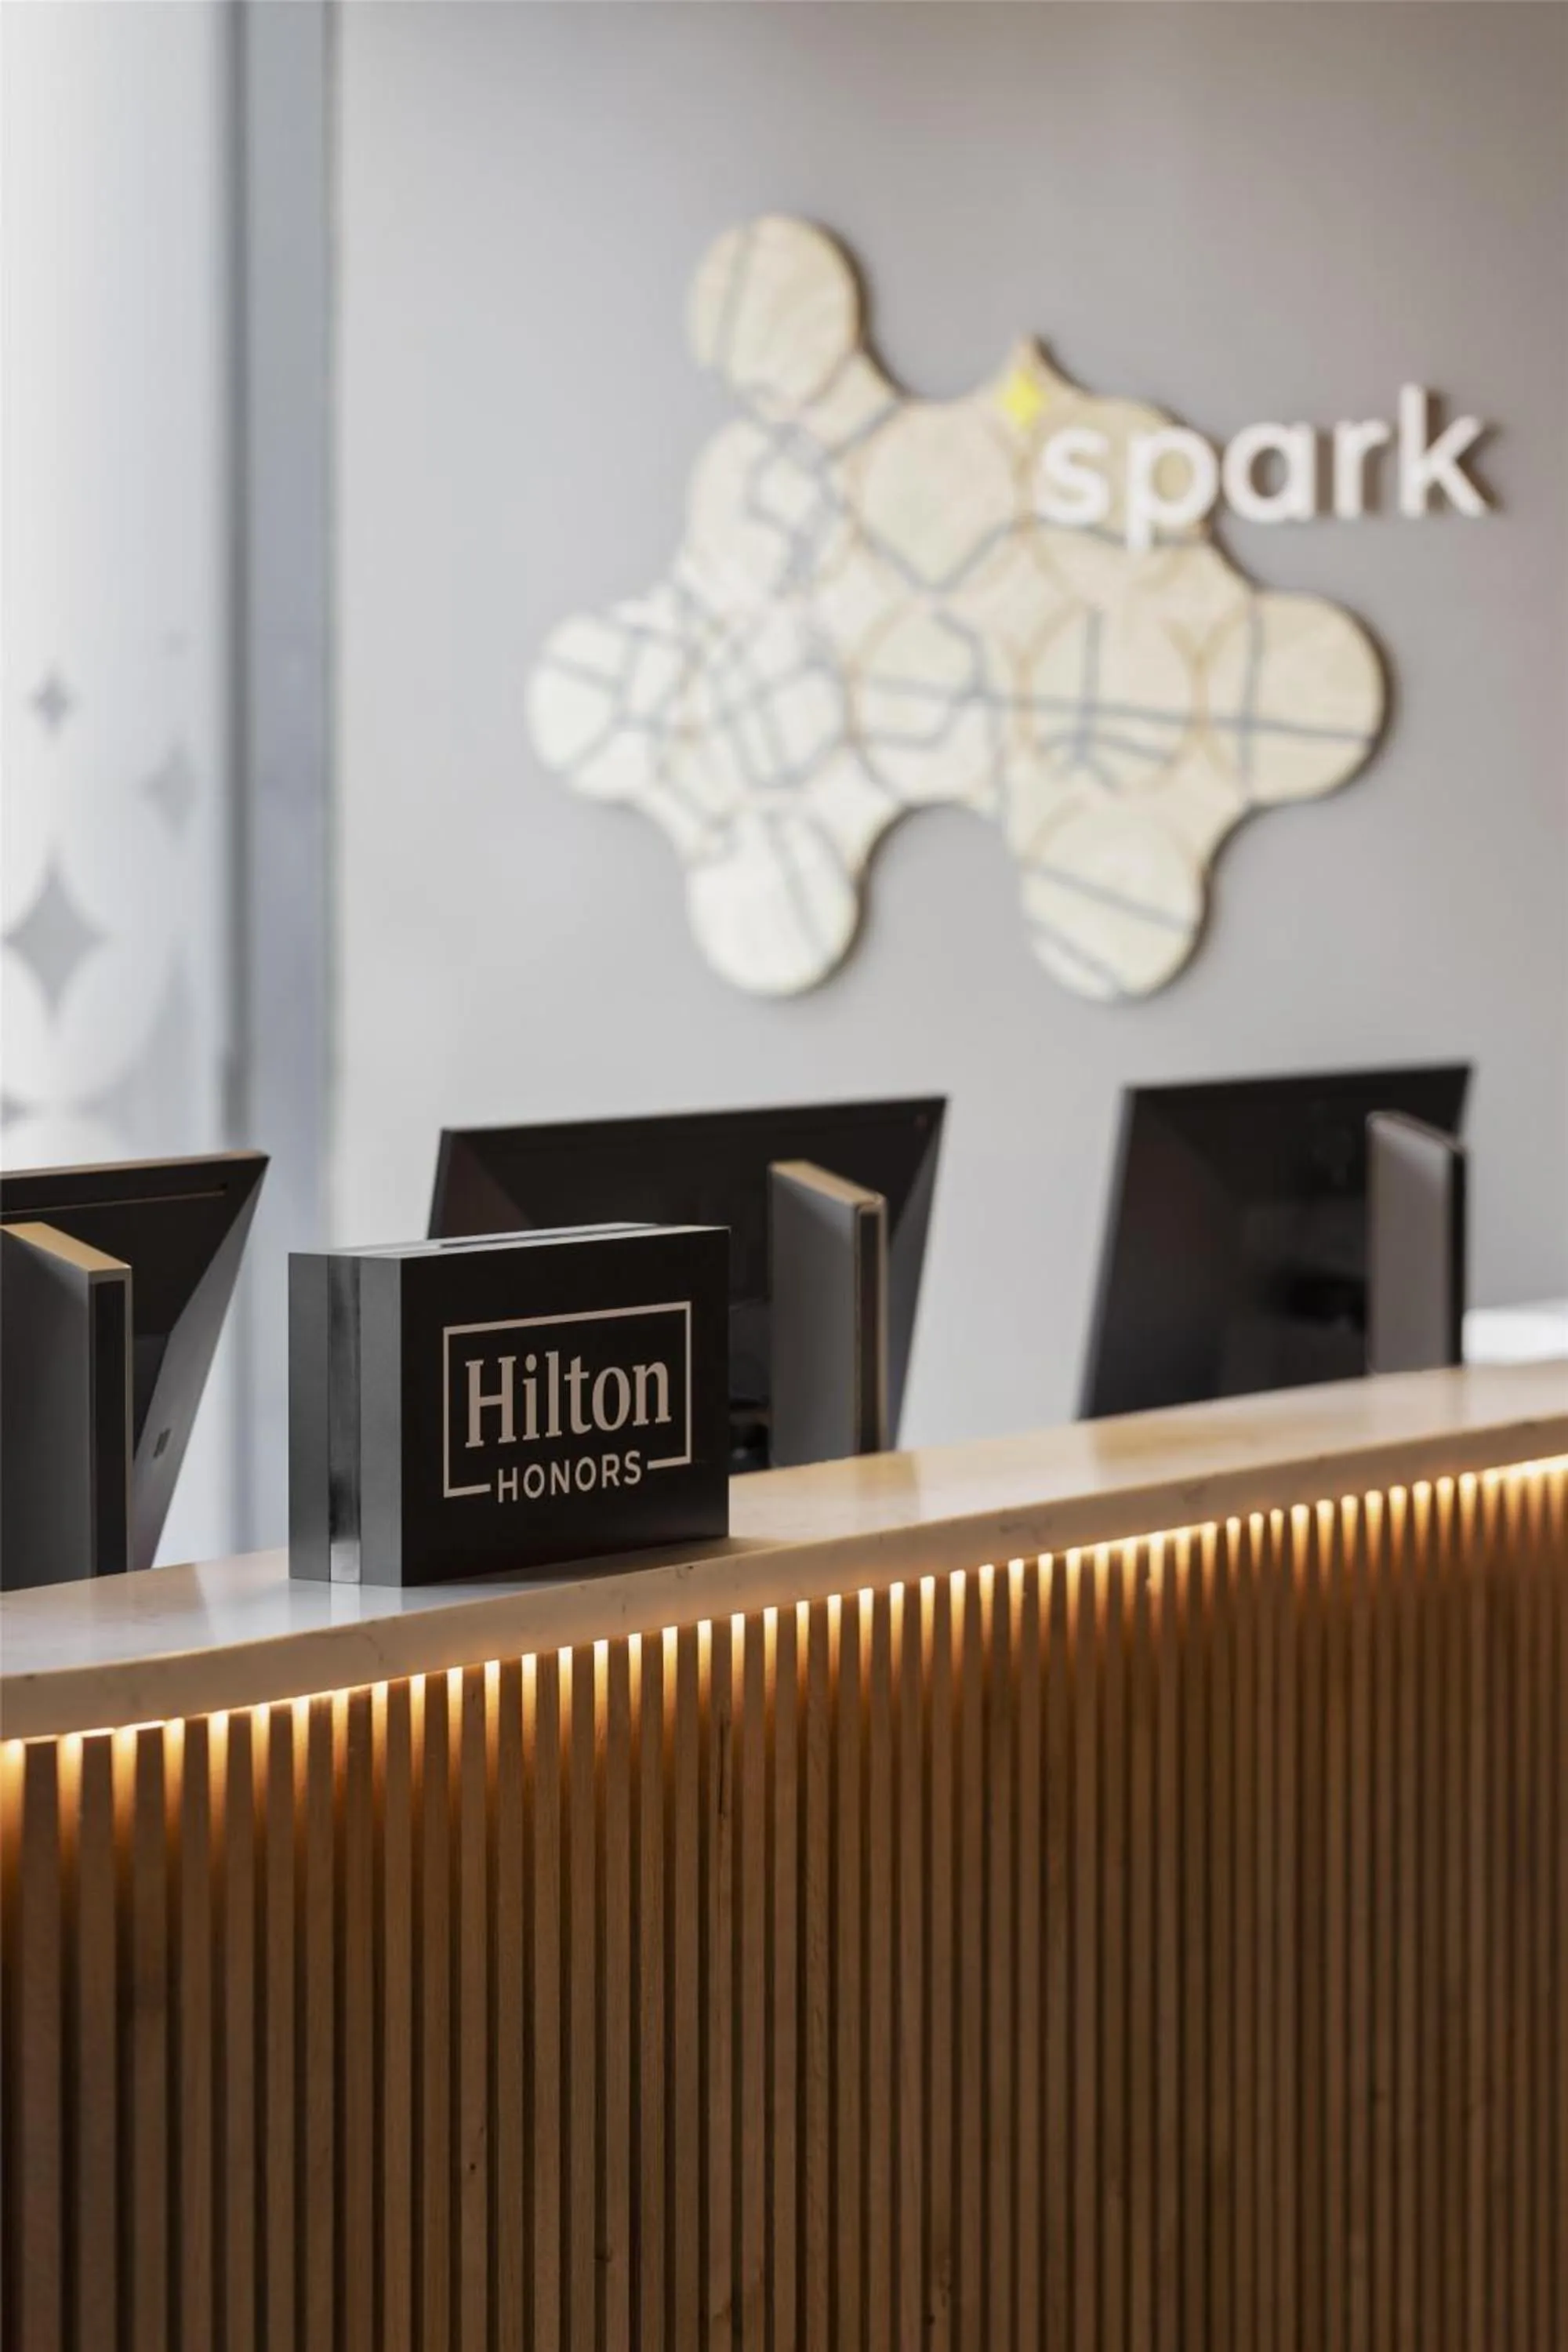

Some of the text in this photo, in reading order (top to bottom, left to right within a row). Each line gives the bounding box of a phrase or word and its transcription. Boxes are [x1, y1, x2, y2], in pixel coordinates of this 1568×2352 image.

[1035, 383, 1486, 554] spark
[465, 1350, 672, 1448] Hilton
[498, 1450, 641, 1503] HONORS
